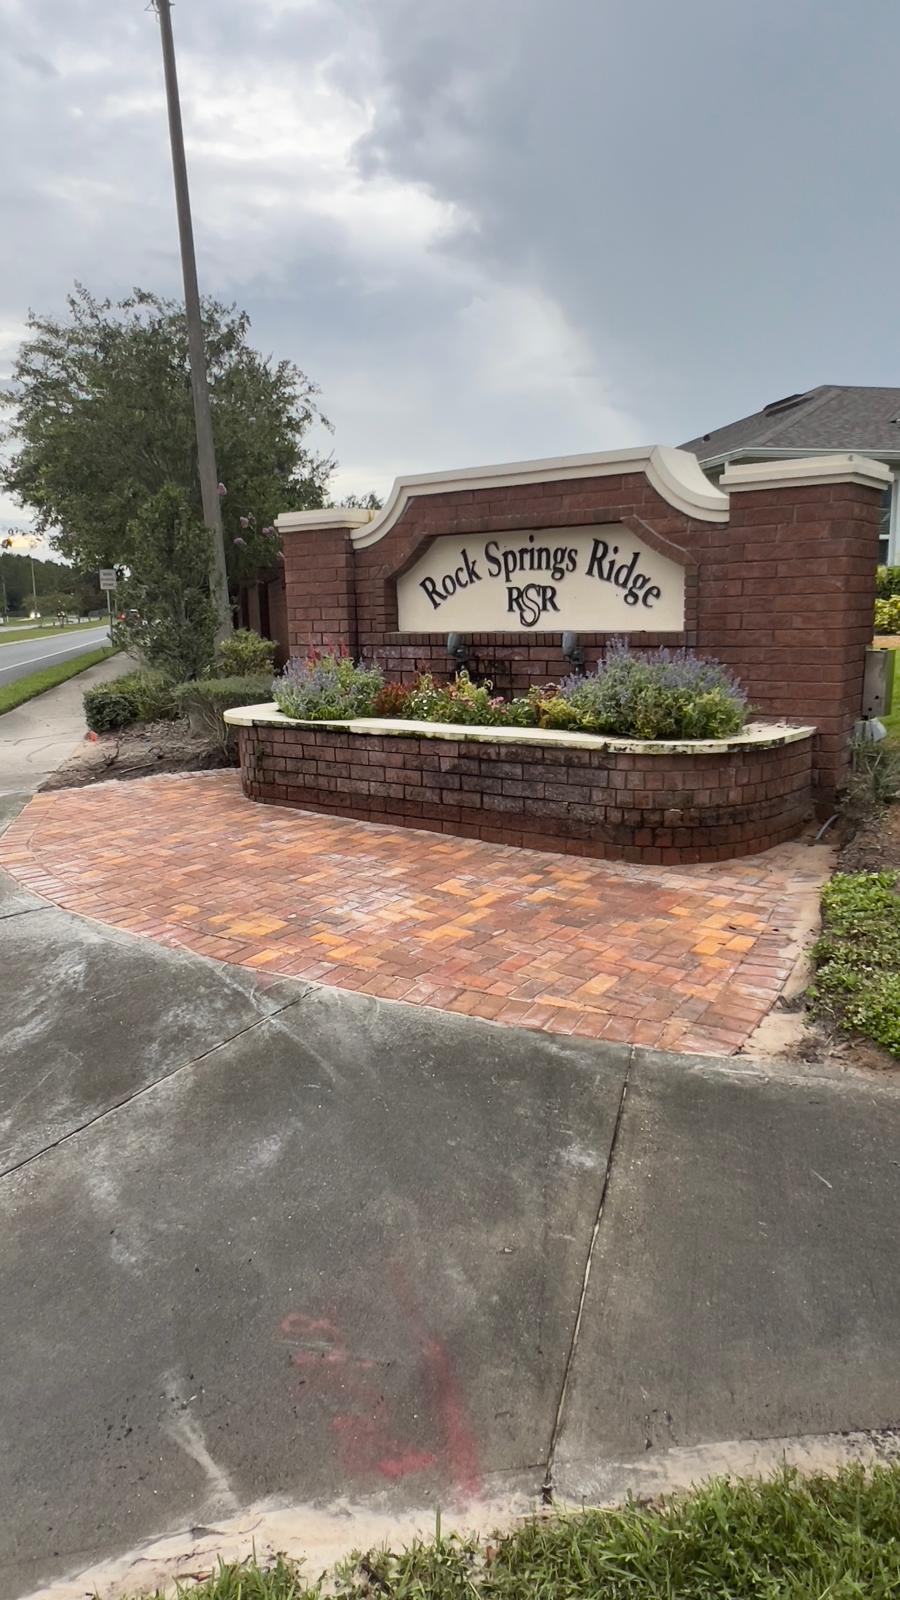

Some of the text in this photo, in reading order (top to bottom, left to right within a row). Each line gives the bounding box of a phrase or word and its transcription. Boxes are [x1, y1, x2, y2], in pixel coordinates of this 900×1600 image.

[419, 535, 661, 610] Rock Springs Ridge
[506, 583, 560, 627] RSR
